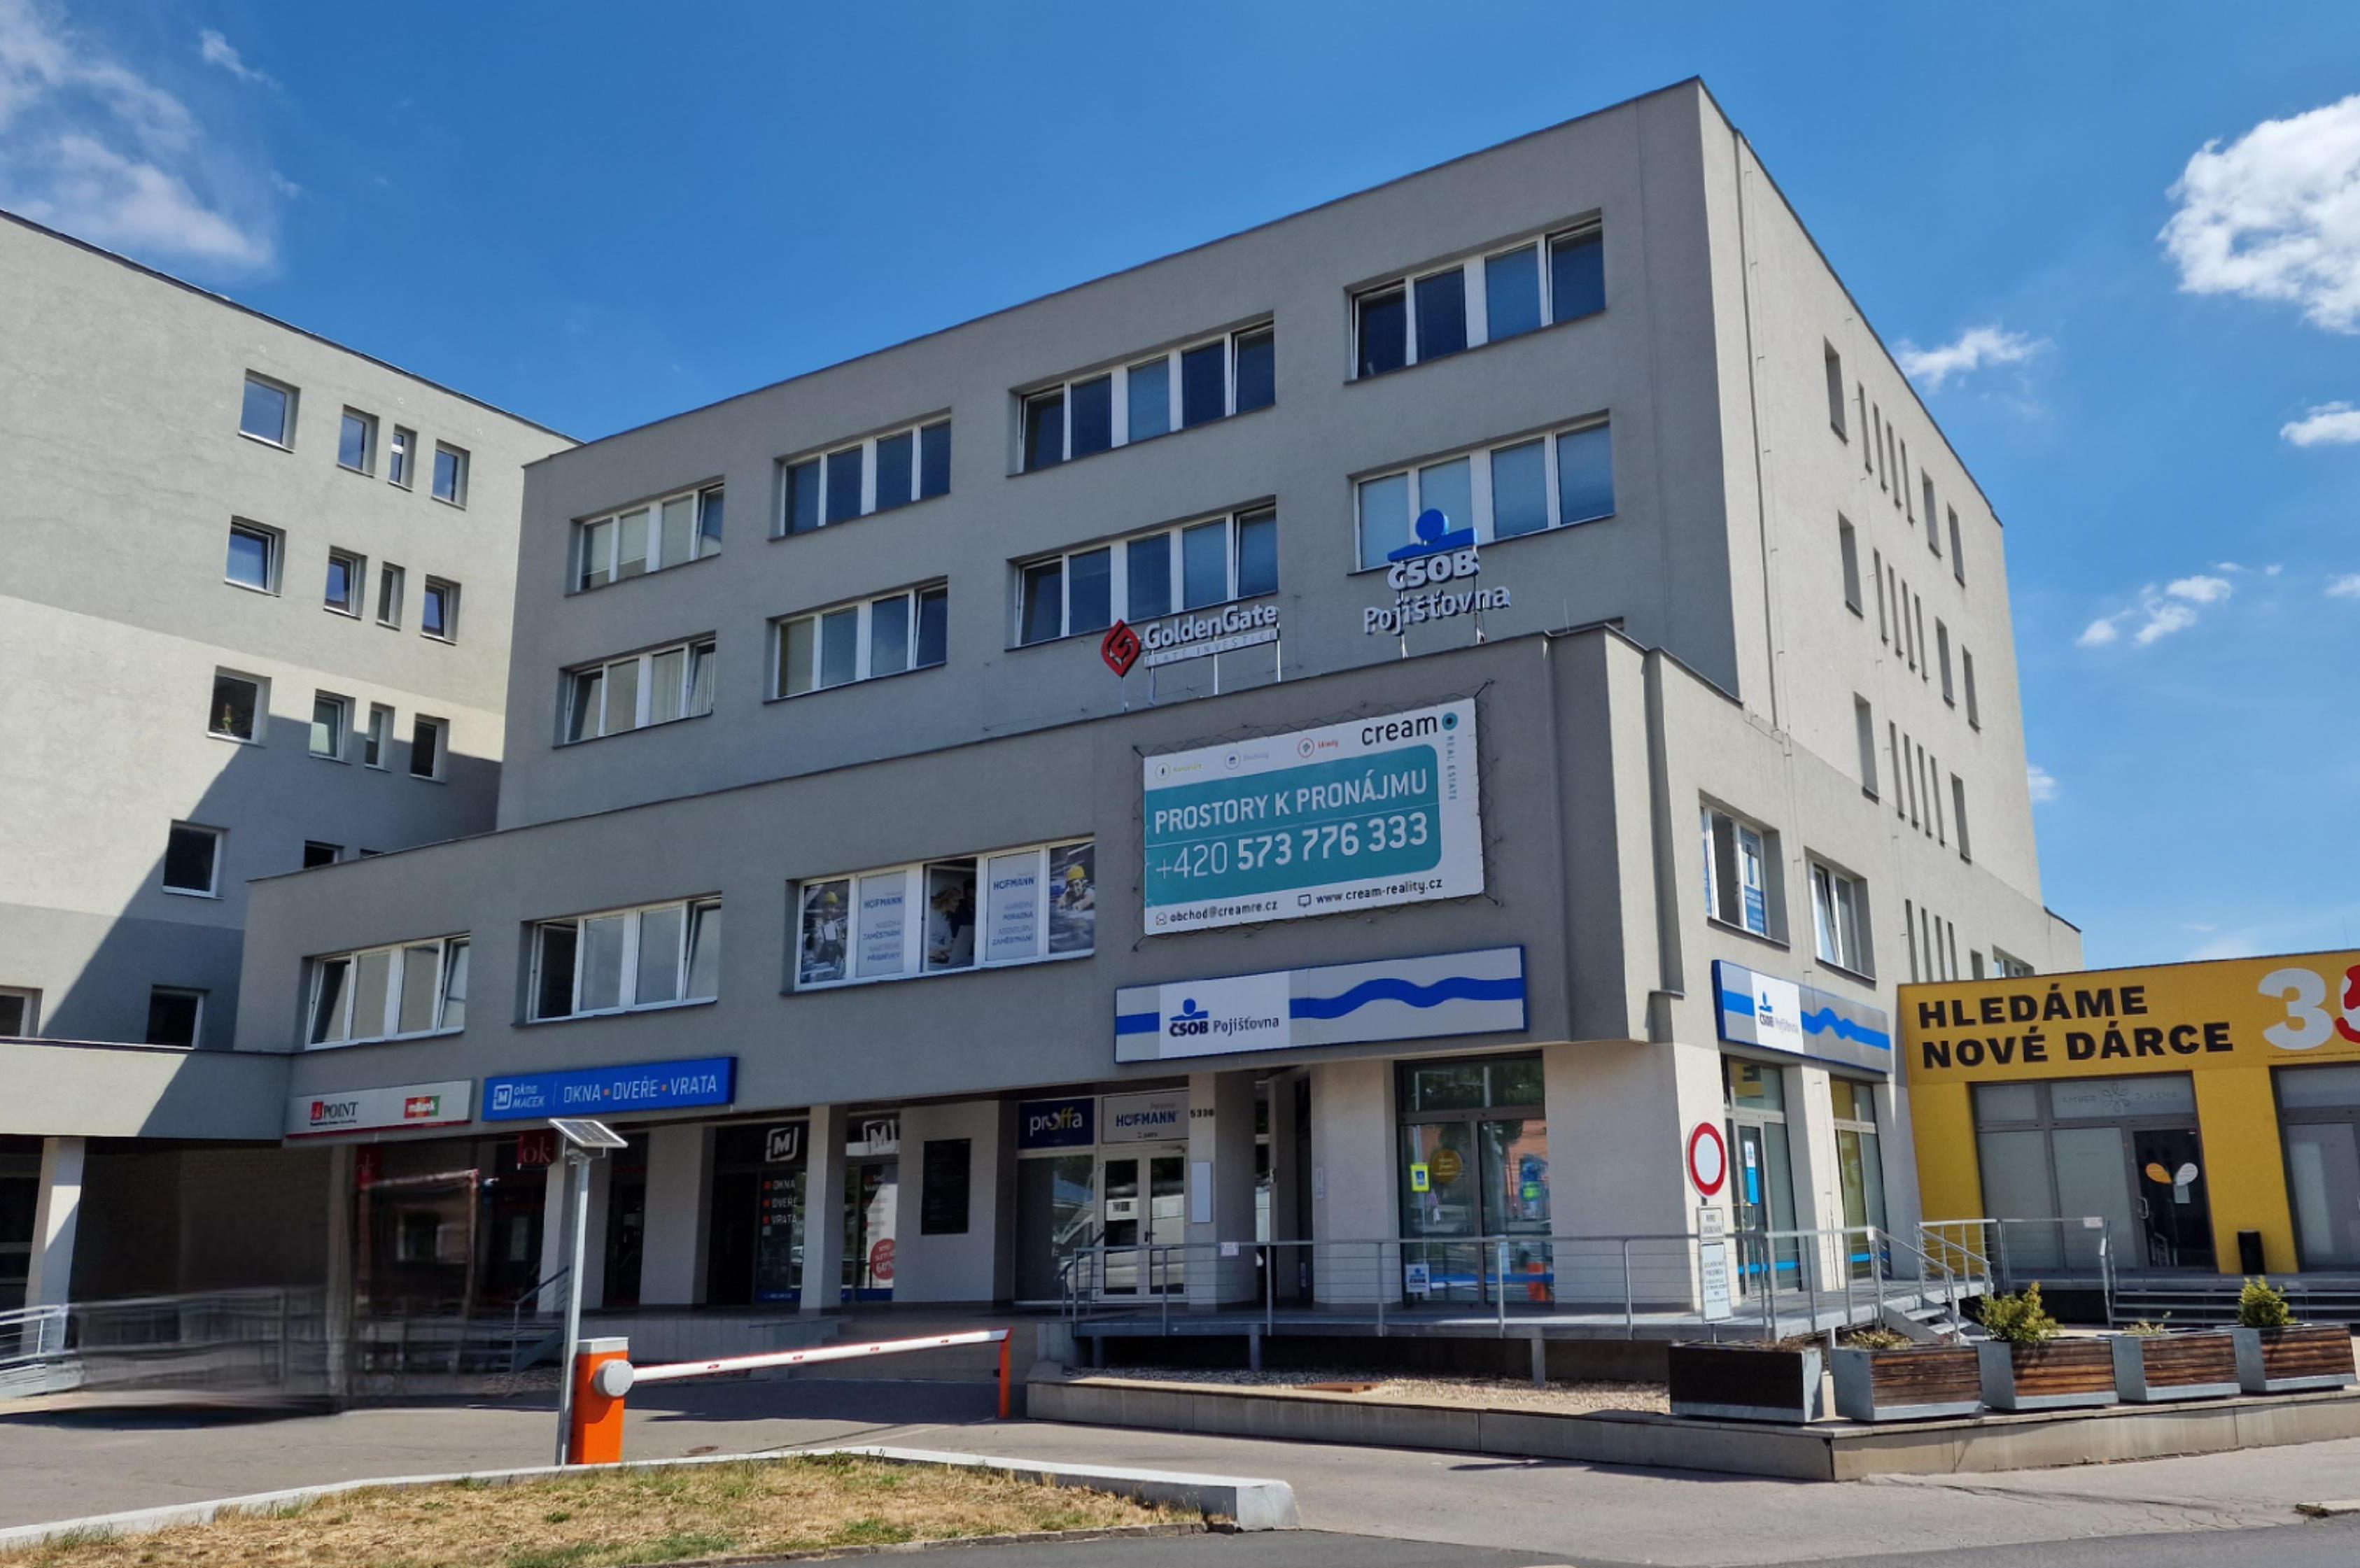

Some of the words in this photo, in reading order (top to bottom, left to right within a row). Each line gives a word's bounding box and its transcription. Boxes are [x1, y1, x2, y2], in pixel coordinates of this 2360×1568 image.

[1387, 550, 1480, 590] ČSOB
[1364, 586, 1510, 635] Pojišťovna
[1144, 605, 1277, 649] GoldenGate
[1362, 715, 1437, 746] cream
[1155, 793, 1269, 834] PROSTORY
[1274, 790, 1288, 817] K
[1295, 769, 1428, 813] PRONÁJMU
[1156, 842, 1228, 880] +420
[1237, 833, 1292, 870] 573
[1302, 824, 1358, 862] 776
[1367, 812, 1428, 852] 333
[993, 877, 1034, 890] HOFMANN
[864, 896, 903, 909] HOFMANN
[1170, 898, 1278, 924] obchod@creamre.cz
[1316, 878, 1442, 905] www.cream-reality.cz
[1918, 983, 2148, 1029] HLEDÁME
[1170, 1019, 1208, 1037] ČSOB
[1213, 1015, 1279, 1035] Pojišťovna
[1923, 1026, 2048, 1069] NOVÉ
[2065, 1019, 2233, 1061] DÁRCE
[512, 1096, 545, 1108] MACEK
[514, 1083, 538, 1095] okna
[564, 1084, 601, 1103] OKNA
[612, 1076, 659, 1101] DVEŘE
[670, 1075, 717, 1096] VRATA
[324, 1101, 358, 1118] POINT
[1030, 1107, 1083, 1136] proffa
[1116, 1110, 1177, 1127] HOFMANN
[523, 1136, 552, 1163] ok
[773, 1180, 795, 1190] OKNA
[771, 1214, 796, 1226] VRATA
